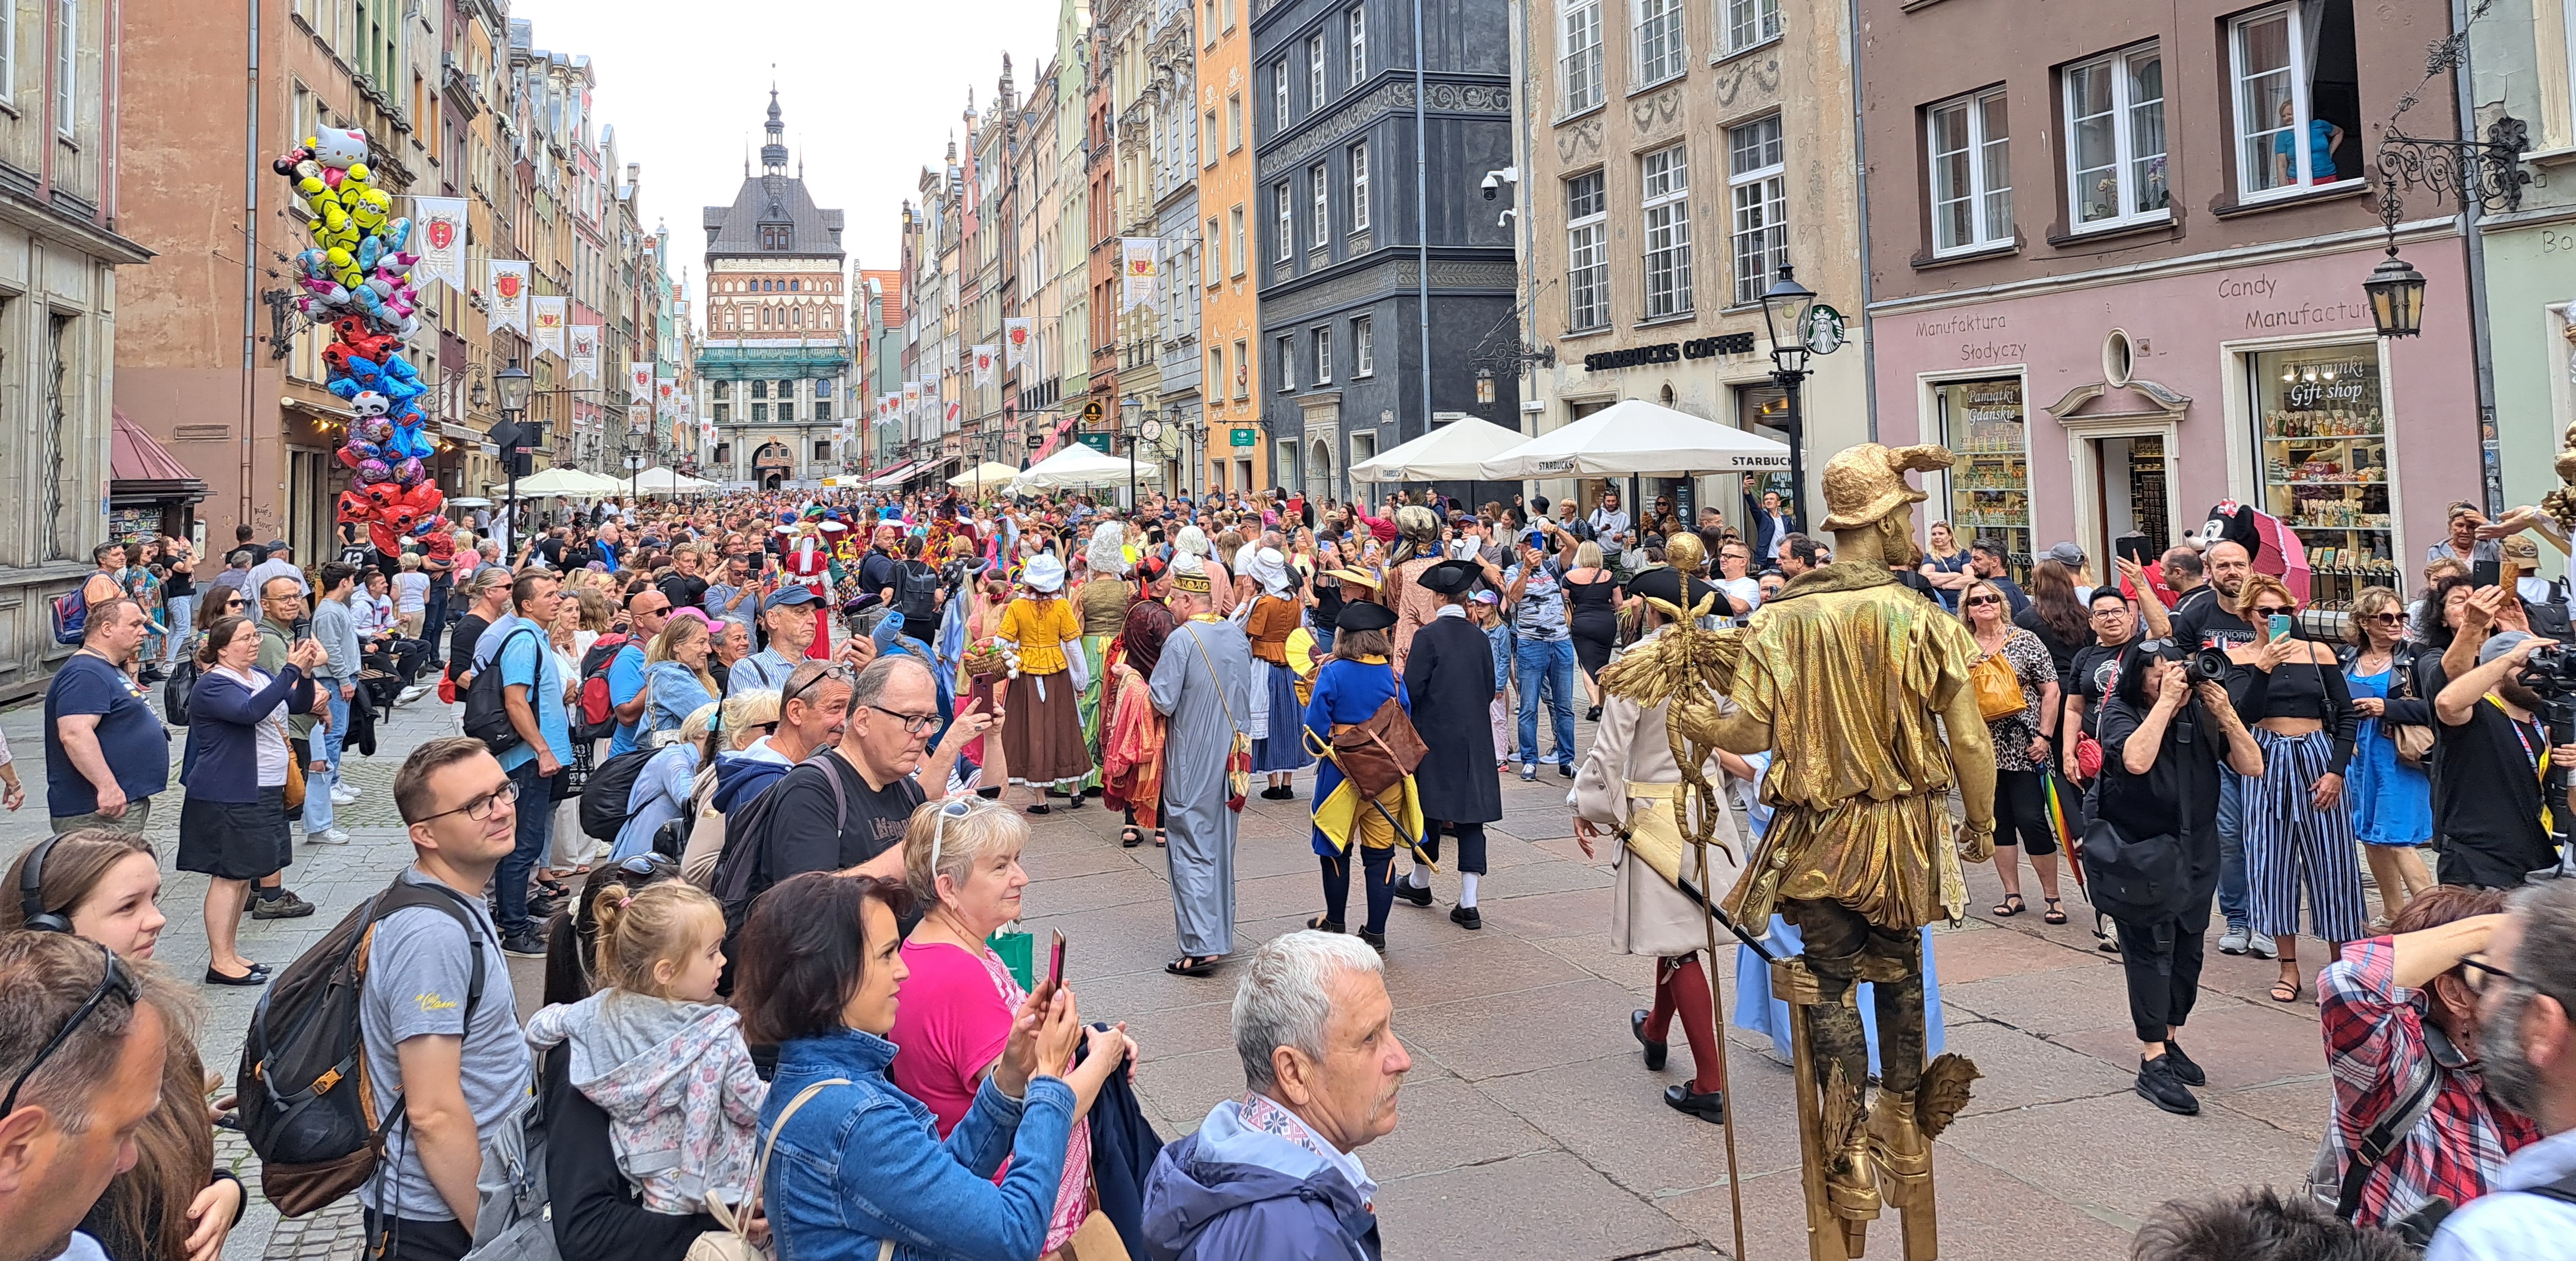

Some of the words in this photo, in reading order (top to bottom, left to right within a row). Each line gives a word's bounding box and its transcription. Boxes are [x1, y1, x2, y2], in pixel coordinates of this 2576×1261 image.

[2218, 273, 2277, 299] Candy
[1916, 313, 2006, 338] Manufaktura
[2245, 300, 2369, 330] Manufactur
[1584, 343, 1679, 372] STARBUCKS
[1682, 332, 1755, 360] COFFEE
[1960, 342, 2027, 363] Słodyczy
[2286, 355, 2365, 383] Upominki
[1967, 385, 2014, 404] Pamiątki
[2291, 381, 2323, 407] Gift
[2326, 379, 2363, 403] shop
[1969, 405, 2016, 426] Gdańskie
[1731, 456, 1792, 466] STARBUCK
[1771, 472, 1793, 482] KAWA
[343, 551, 364, 570] 42
